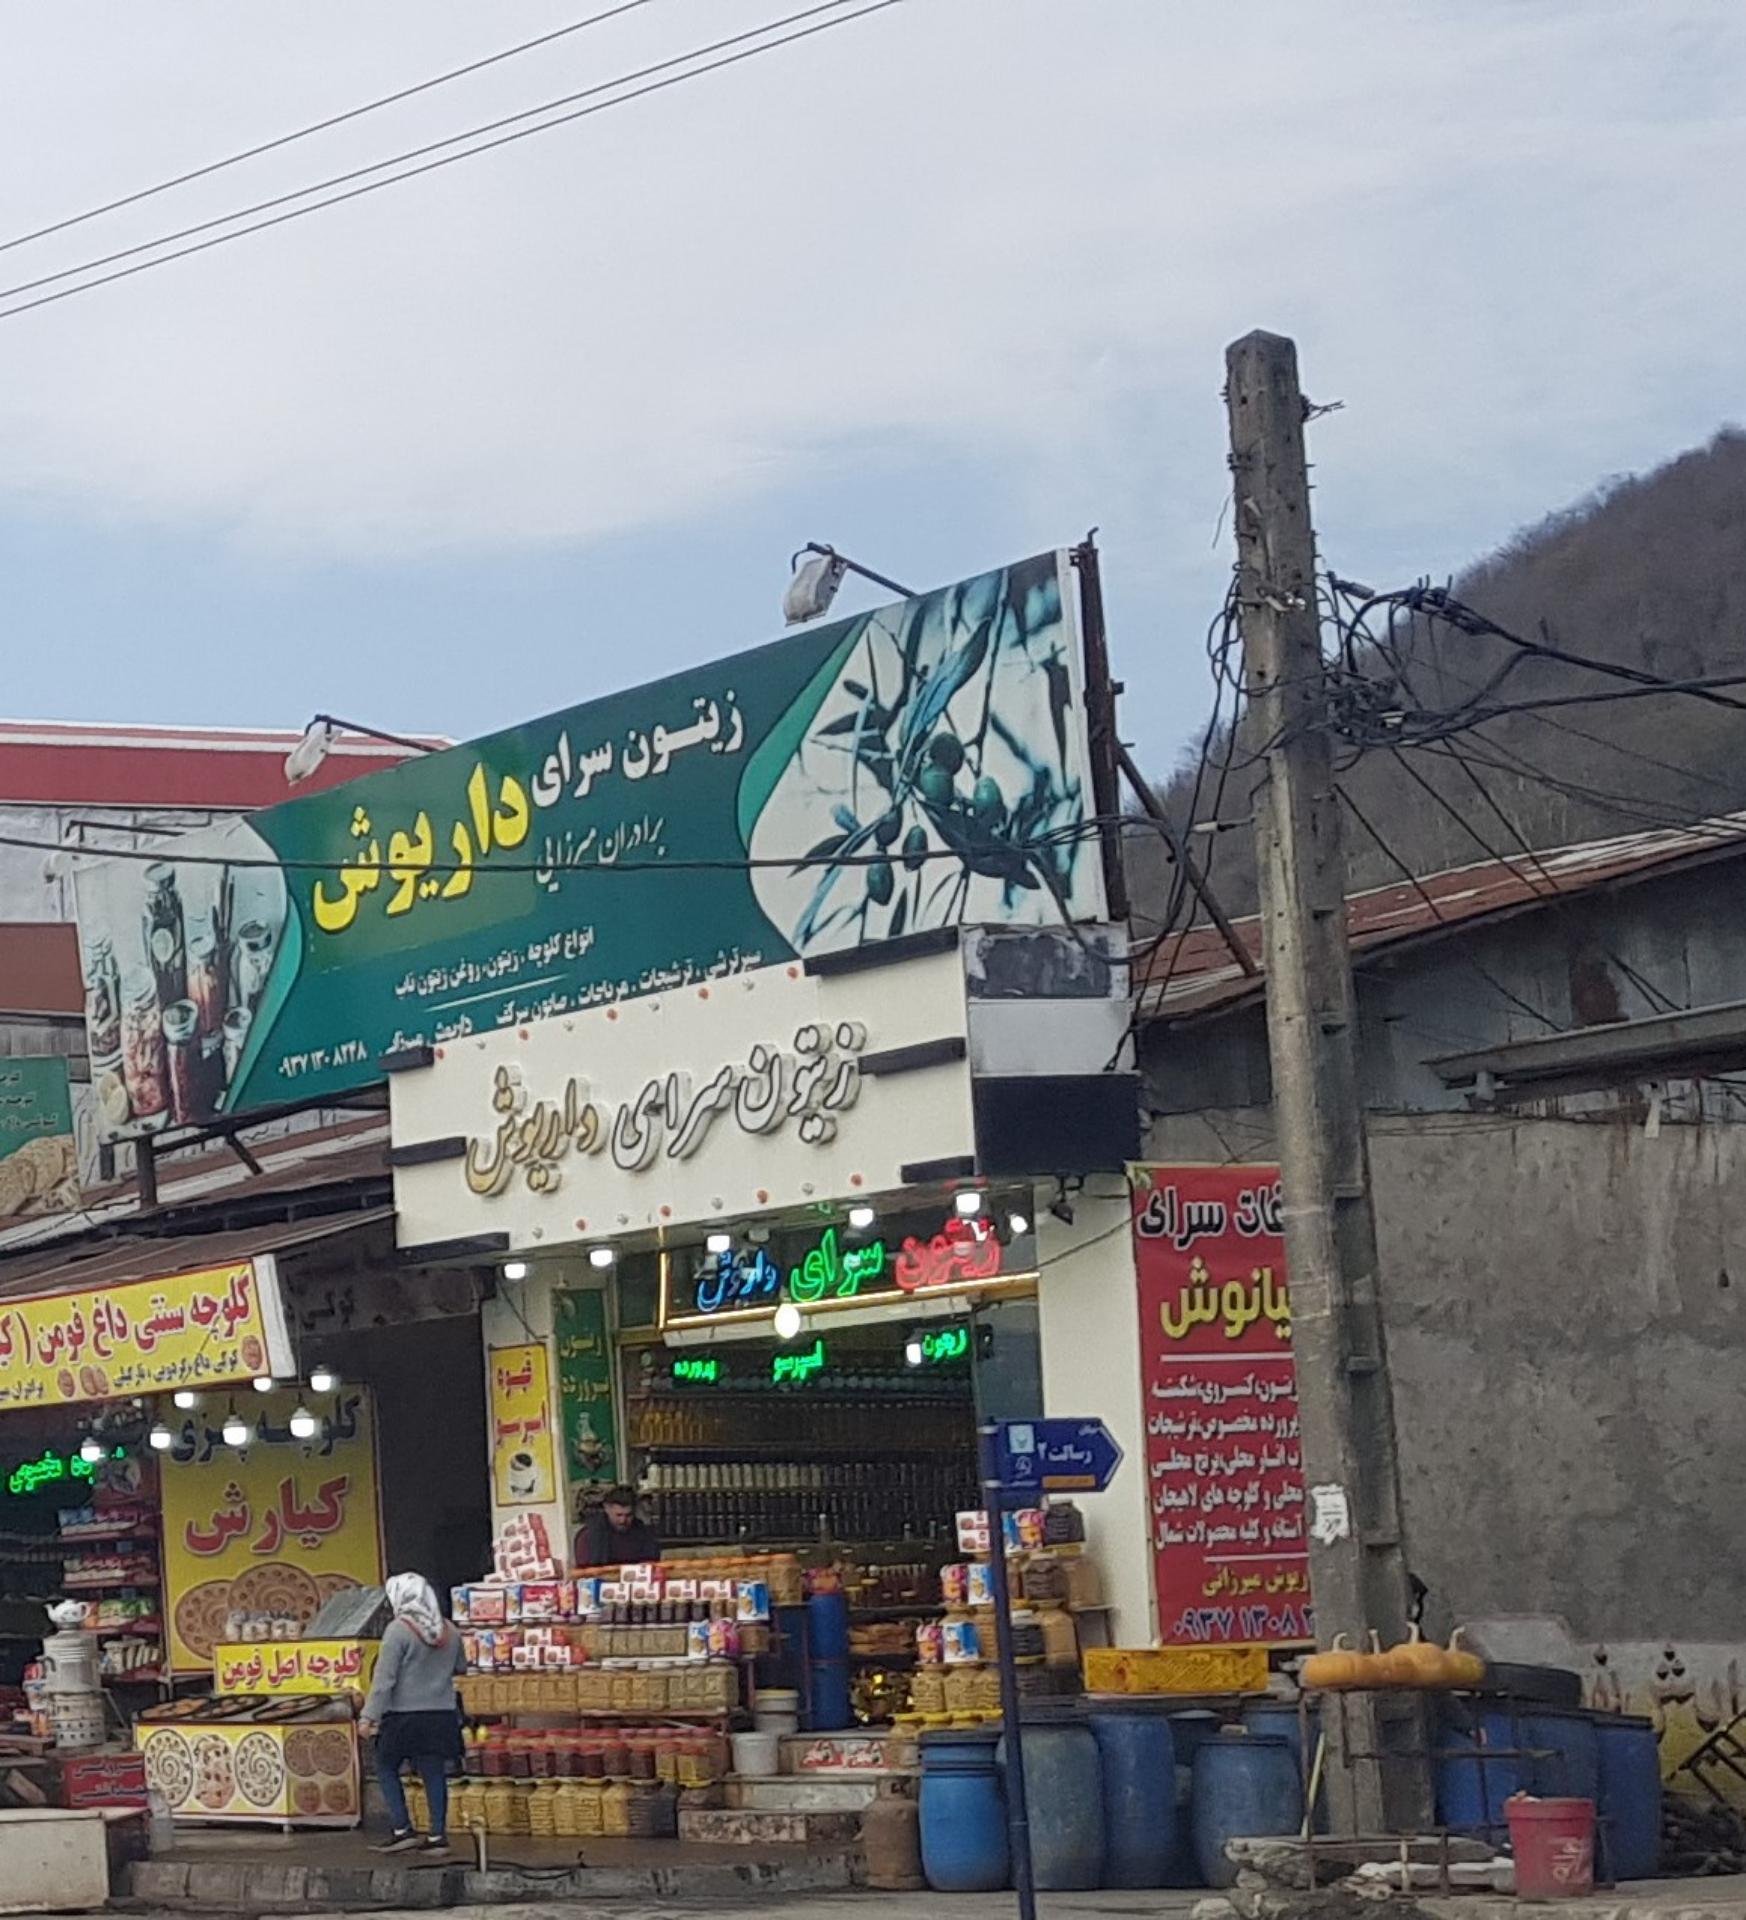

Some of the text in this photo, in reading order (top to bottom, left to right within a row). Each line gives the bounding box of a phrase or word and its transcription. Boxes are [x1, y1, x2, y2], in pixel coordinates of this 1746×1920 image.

[313, 689, 744, 931] زیتون سرای داریوش
[598, 813, 665, 864] برادران
[564, 926, 595, 960] انواع
[417, 968, 448, 996] زیتون
[450, 958, 481, 988] روغن
[466, 1022, 864, 1195] زیتون سرای داریوش
[1137, 1181, 1285, 1250] غات سرای
[791, 1227, 884, 1302] سرای
[190, 1273, 251, 1340] کلوچه
[1160, 1256, 1292, 1338] یانوش
[37, 1301, 86, 1365] فومن
[92, 1297, 127, 1358] داغ
[135, 1296, 185, 1351] سنتی
[1048, 1443, 1093, 1465] رسالت
[1151, 1446, 1192, 1477] محلی
[184, 1474, 349, 1555] کیارش
[1153, 1483, 1198, 1514] لاهیجان
[1200, 1482, 1225, 1513] های
[1226, 1480, 1261, 1512] کلوچه
[1155, 1520, 1184, 1550] شمال
[1264, 1564, 1309, 1593] ریوش
[1173, 1606, 1235, 1640] ۰۹۳۷
[222, 1646, 364, 1689] کلوچه اصل فومن
